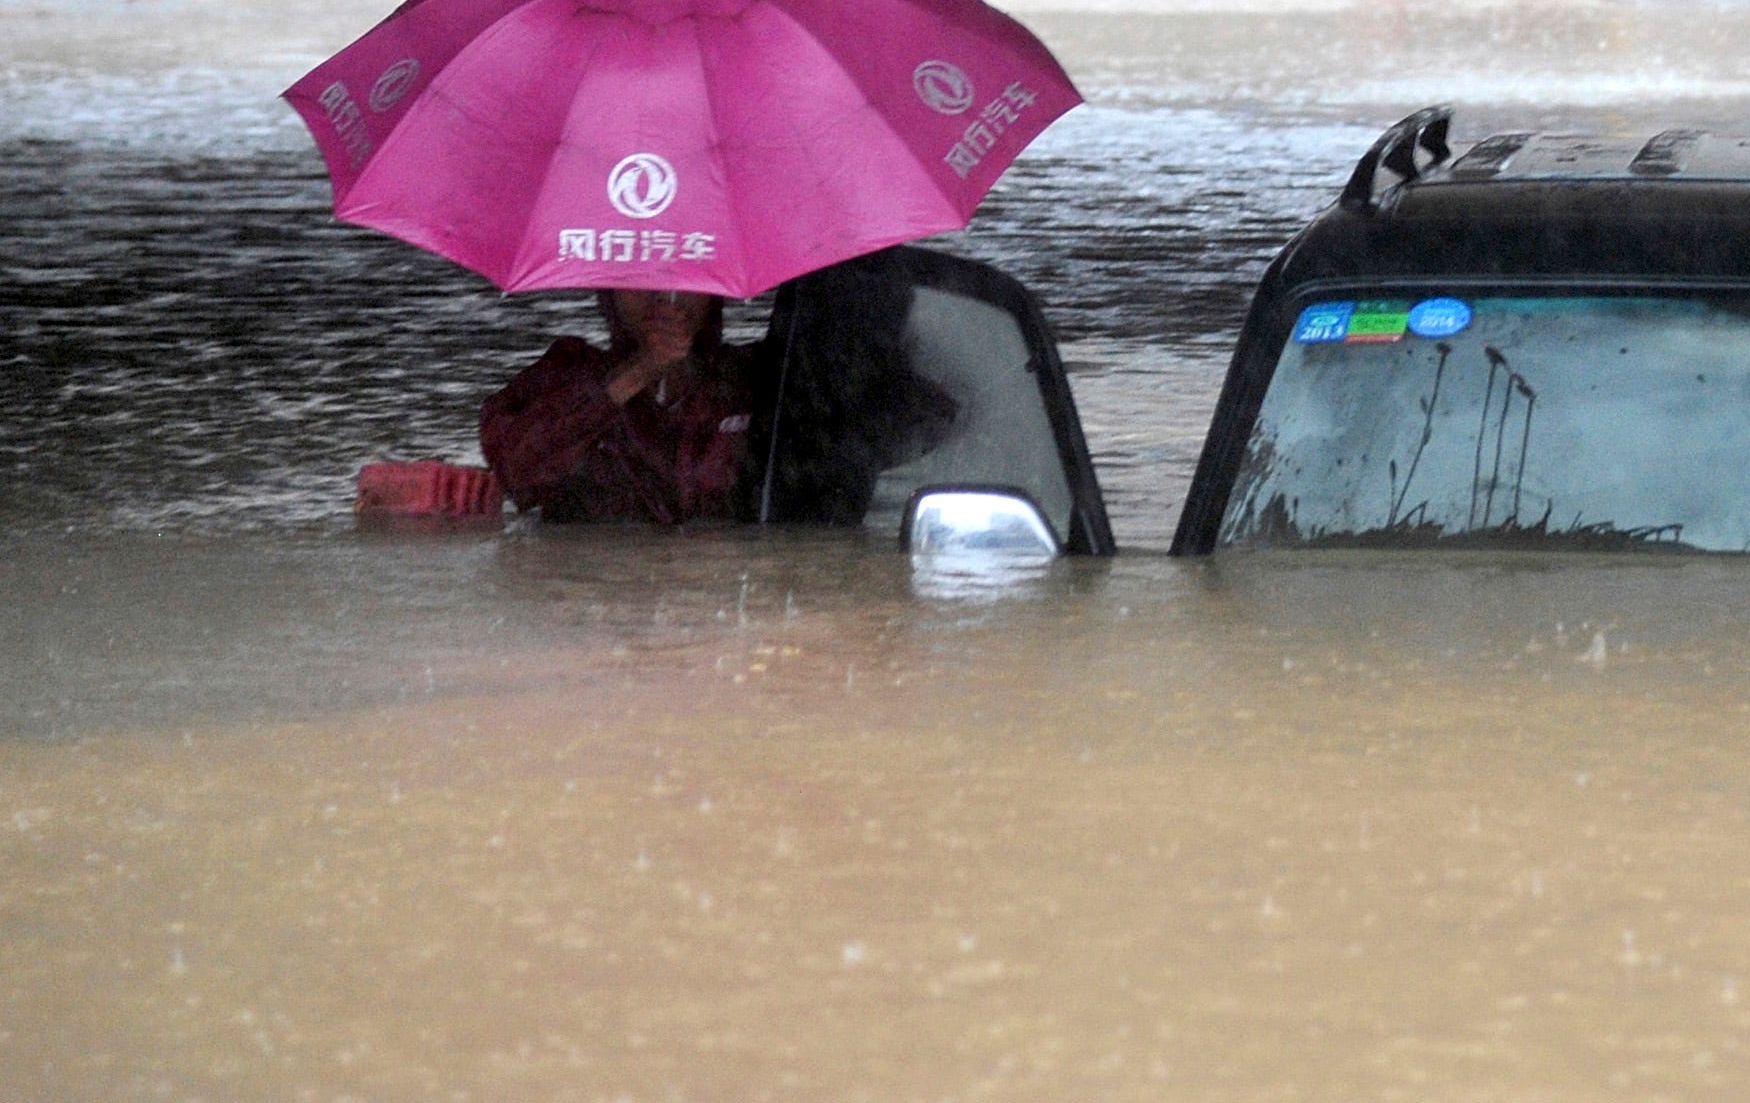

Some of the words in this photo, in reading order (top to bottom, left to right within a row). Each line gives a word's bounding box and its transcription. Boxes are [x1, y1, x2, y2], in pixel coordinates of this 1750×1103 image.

[943, 80, 1039, 180] 风行汽车
[557, 228, 716, 262] 风行汽车
